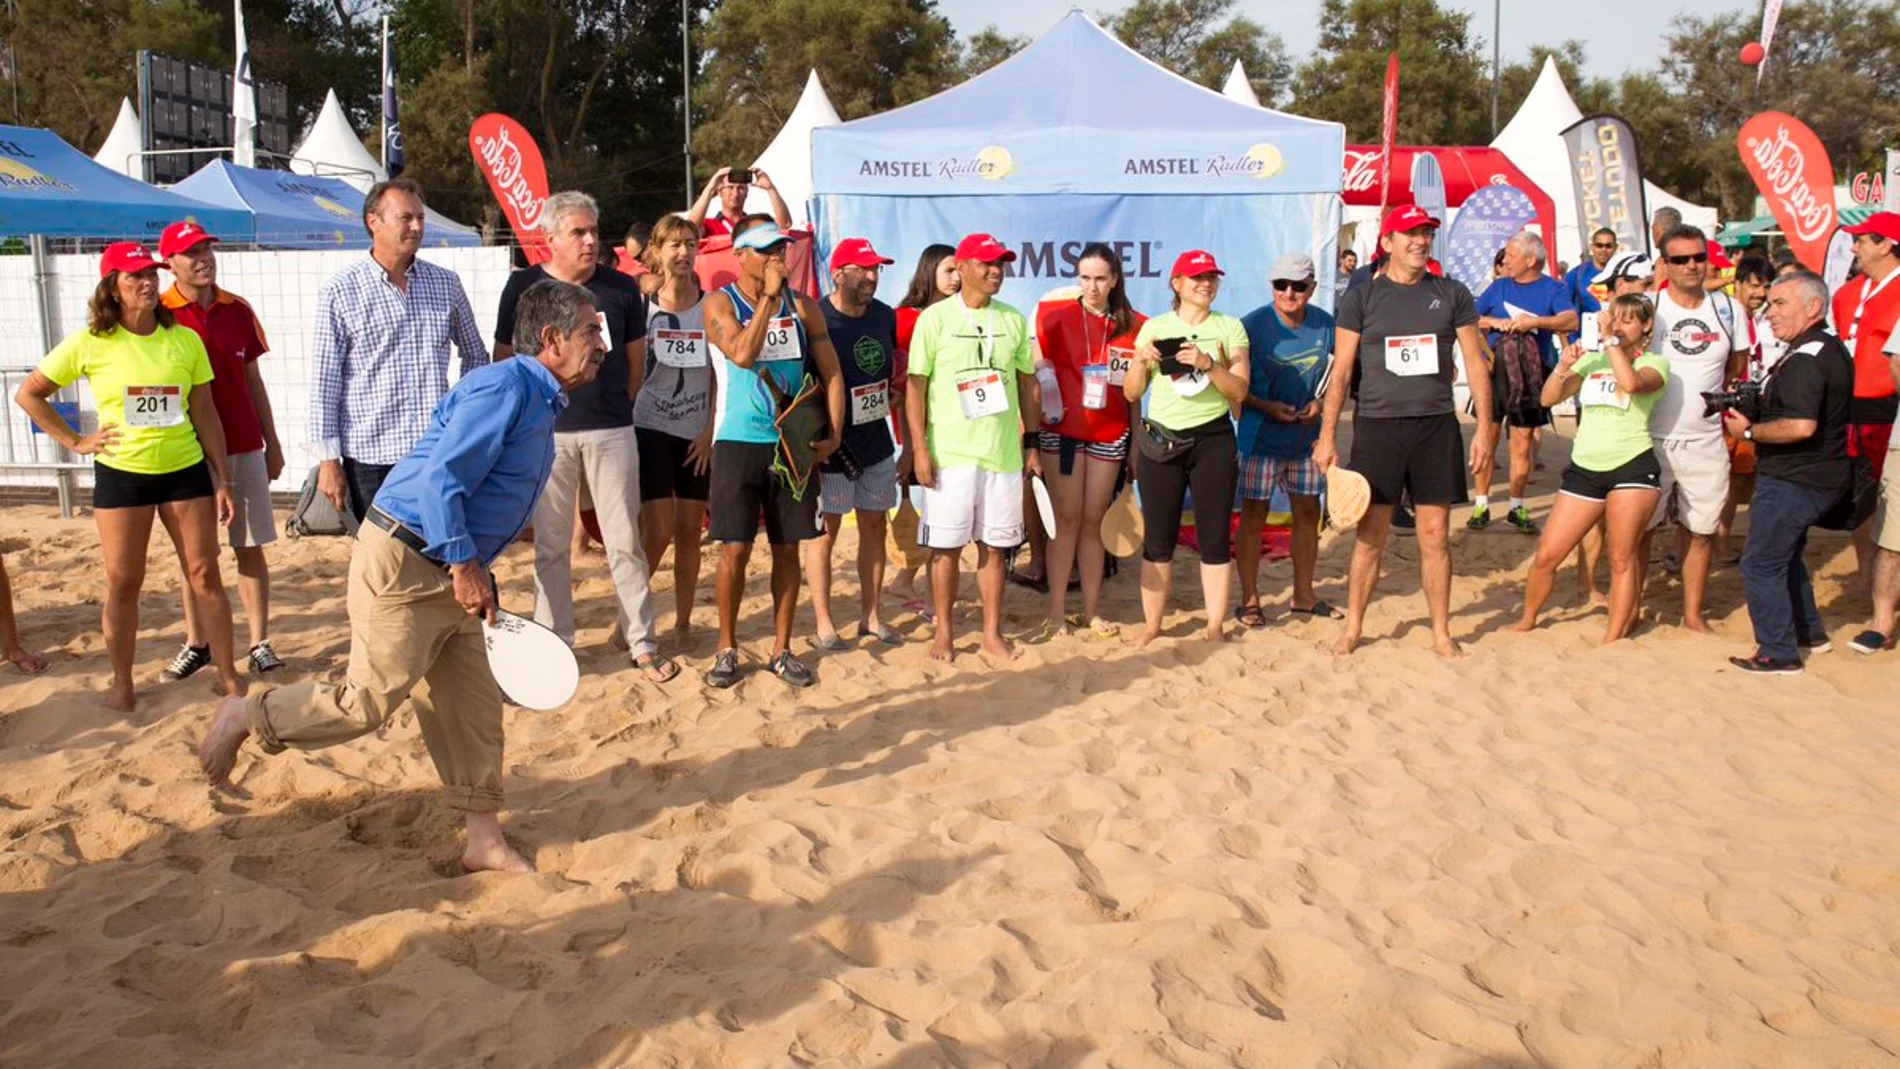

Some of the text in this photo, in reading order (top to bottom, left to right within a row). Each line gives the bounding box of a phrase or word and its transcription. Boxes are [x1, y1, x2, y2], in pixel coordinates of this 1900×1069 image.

[859, 157, 997, 180] AMSTEL Radler
[1124, 154, 1266, 178] AMSTEL Radler
[998, 241, 1162, 278] MSEL
[665, 340, 695, 354] 784
[1400, 348, 1420, 363] 61
[1110, 358, 1128, 372] 04
[1600, 380, 1617, 393] 10
[861, 393, 884, 410] 284
[975, 387, 986, 402] 9
[136, 396, 168, 412] 201
